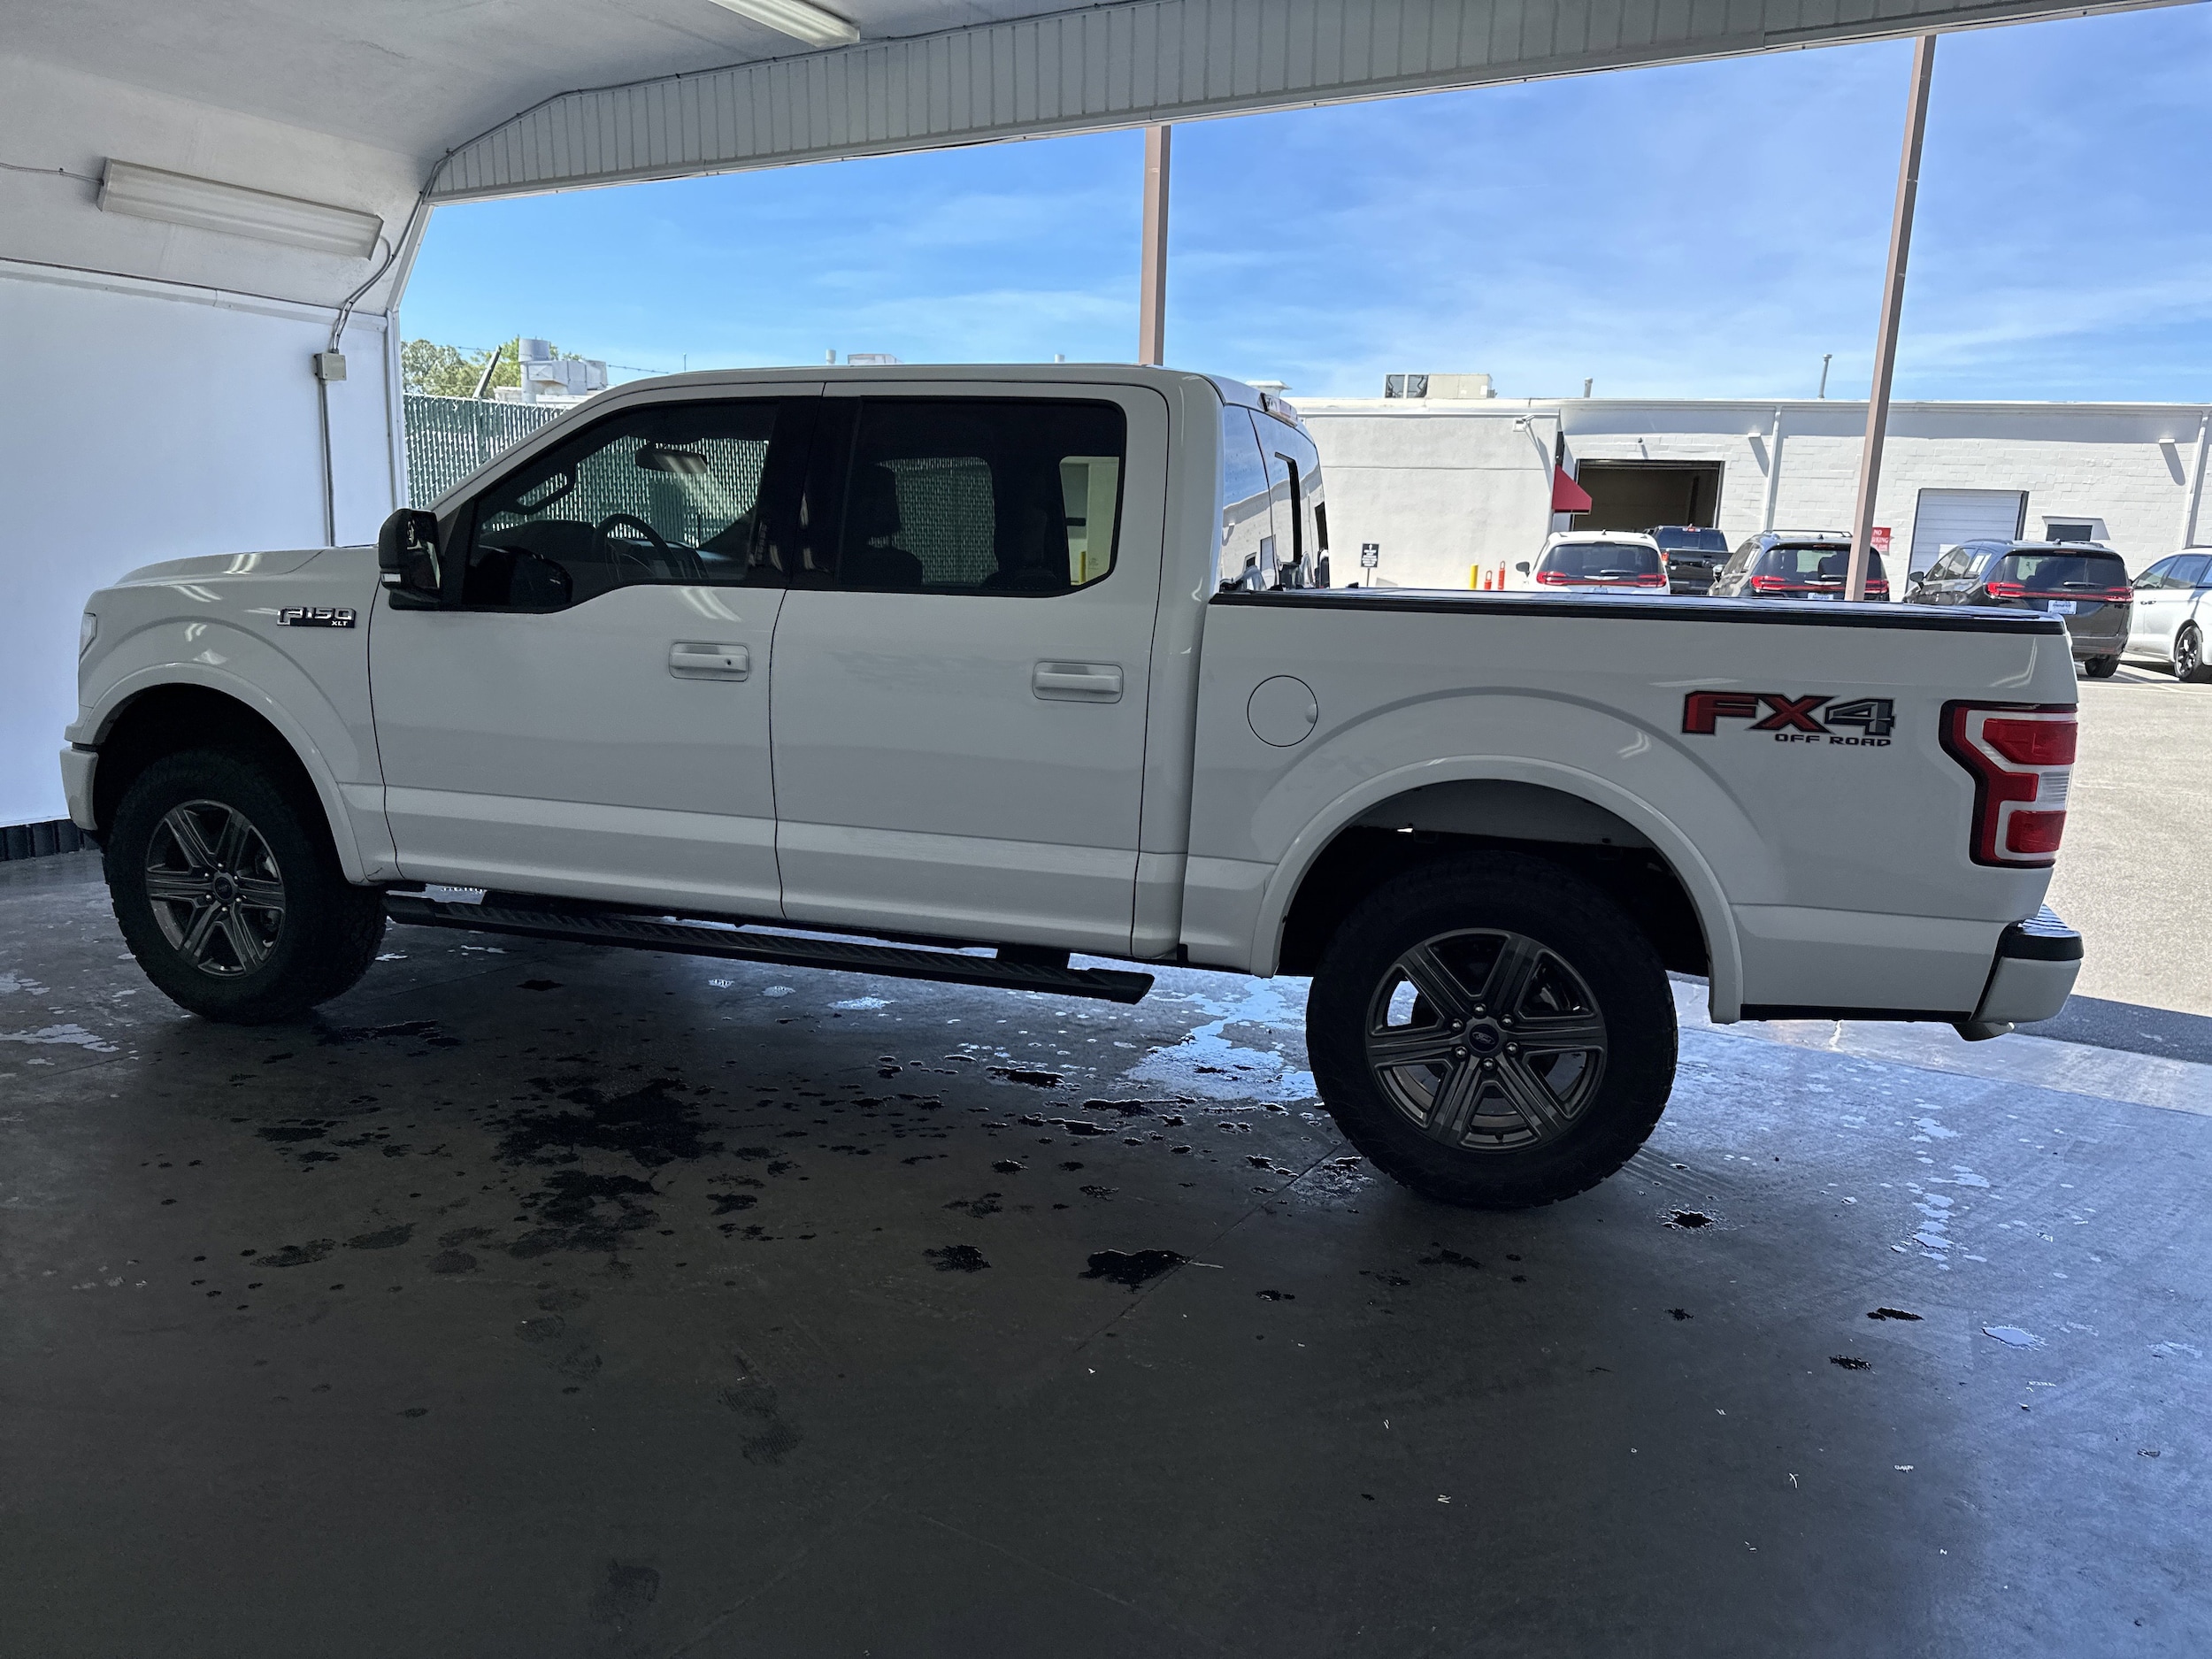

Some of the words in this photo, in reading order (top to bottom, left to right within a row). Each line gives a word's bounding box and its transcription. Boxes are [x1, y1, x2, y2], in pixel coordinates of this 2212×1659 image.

[1682, 691, 1894, 736] FX4
[1775, 733, 1820, 743] OFF
[1829, 736, 1891, 747] ROAD
